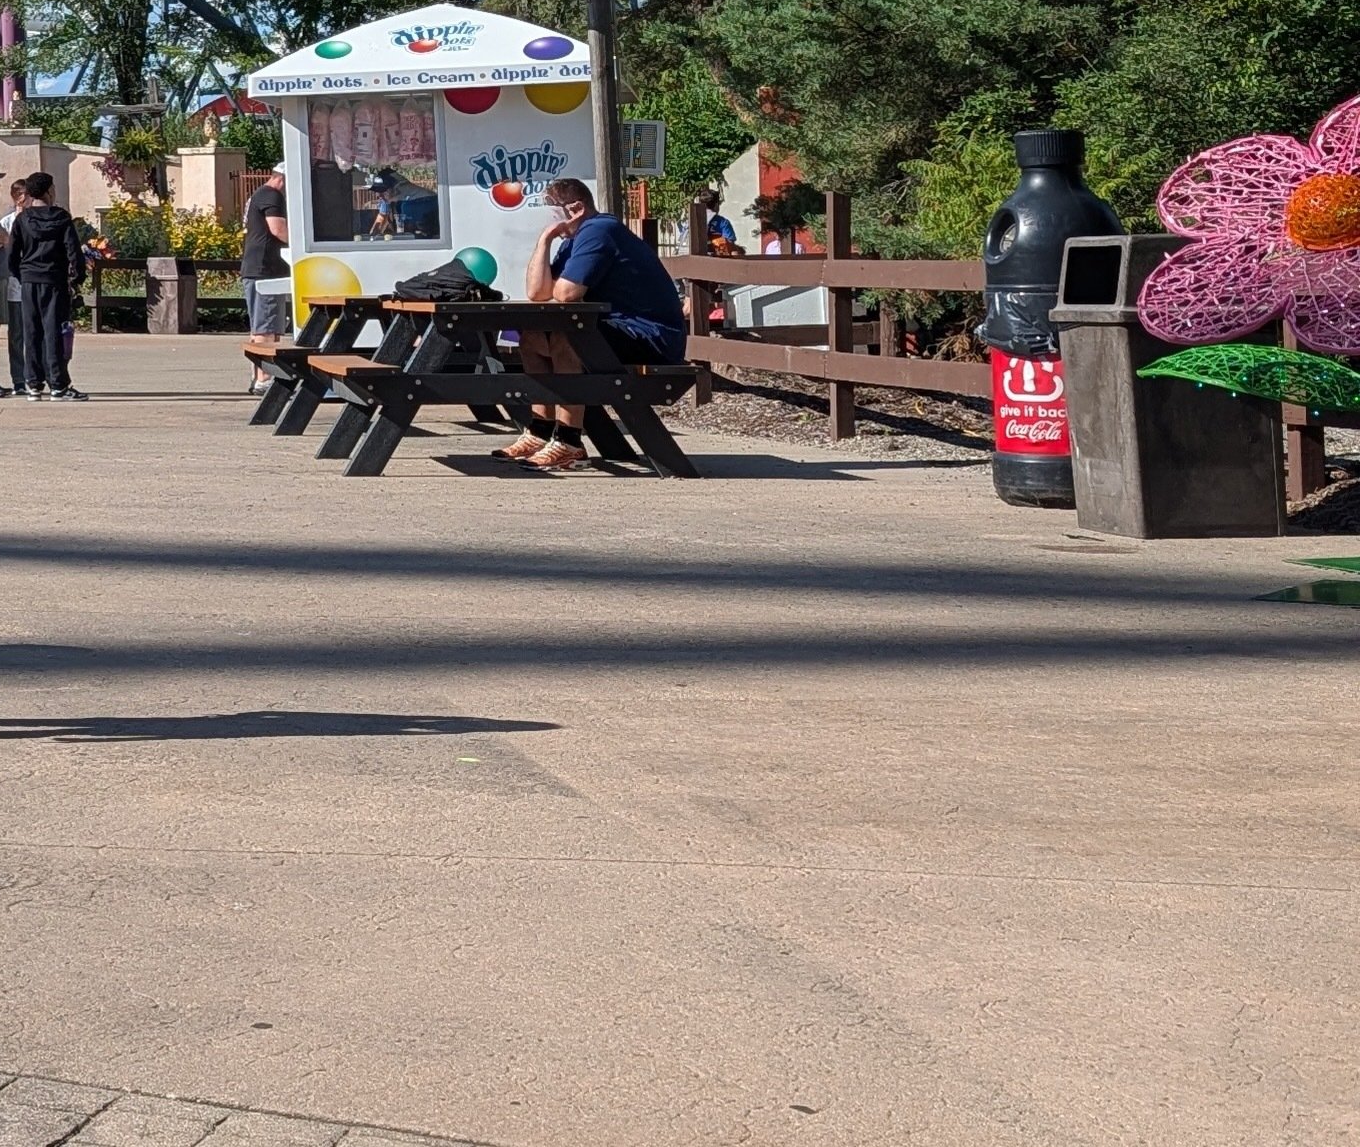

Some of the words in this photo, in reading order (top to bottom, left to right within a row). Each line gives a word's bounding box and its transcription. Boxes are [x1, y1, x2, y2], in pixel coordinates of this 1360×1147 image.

[258, 77, 316, 92] dippin'
[387, 73, 412, 86] Ice
[417, 71, 475, 85] Cream
[491, 65, 554, 82] dippin'
[559, 63, 591, 77] dot
[473, 142, 564, 189] dippin'
[1000, 403, 1021, 418] give
[1024, 404, 1034, 417] it
[1038, 405, 1066, 418] bac
[1006, 419, 1065, 442] Coca-Cola
